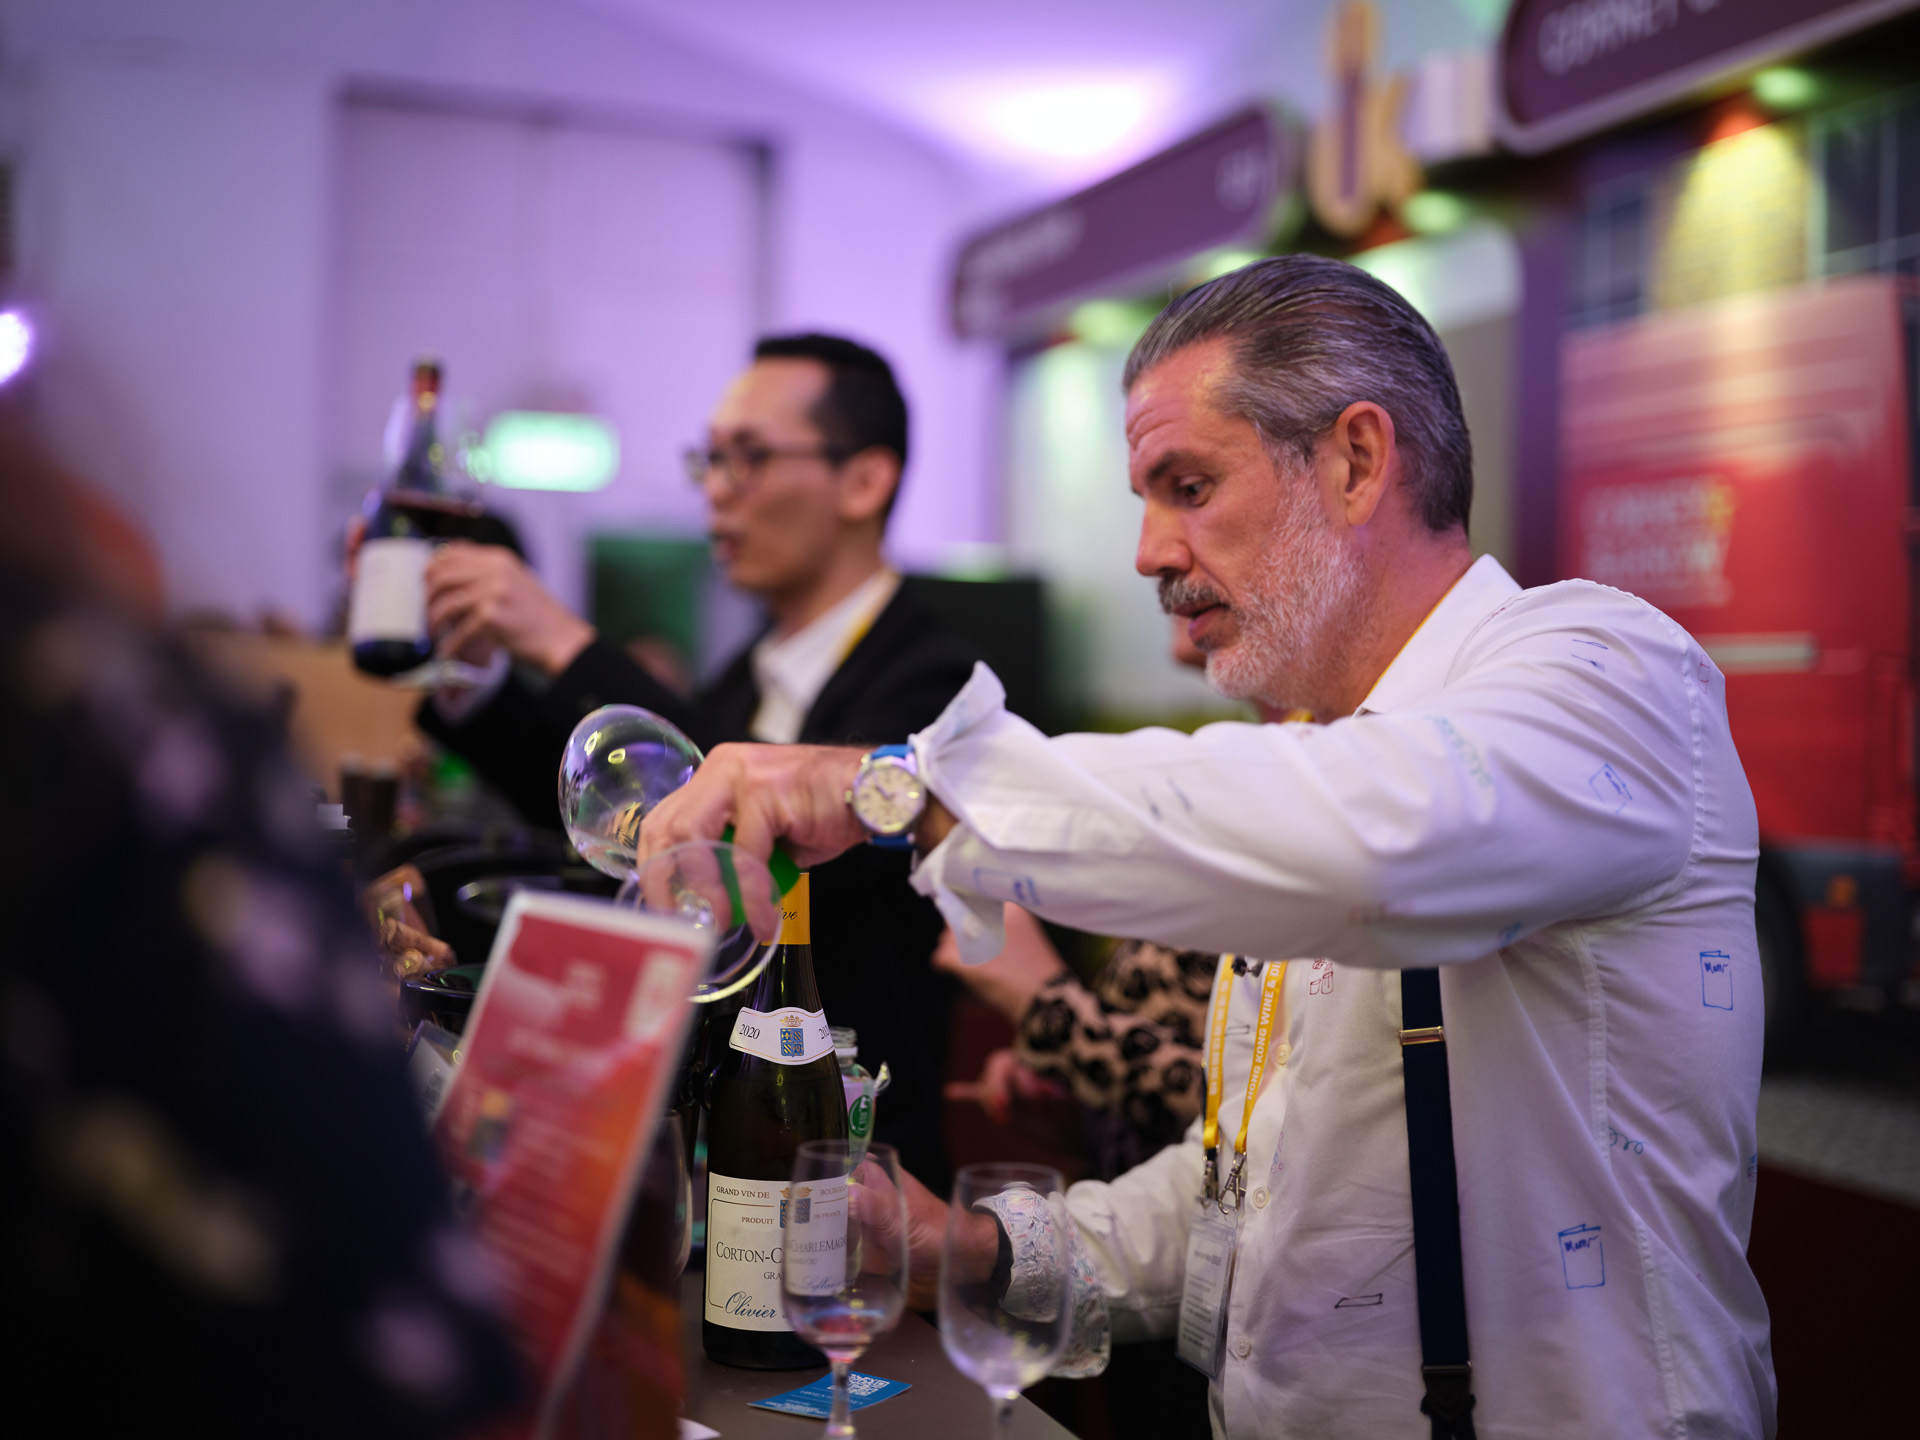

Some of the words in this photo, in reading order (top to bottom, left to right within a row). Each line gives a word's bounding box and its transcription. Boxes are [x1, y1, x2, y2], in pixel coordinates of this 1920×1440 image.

[1266, 979, 1277, 990] &
[1260, 990, 1275, 1026] WINE
[739, 1023, 761, 1040] 2020
[818, 1024, 831, 1040] 202
[1255, 1029, 1268, 1063] KONG
[1247, 1066, 1262, 1100] HONG
[716, 1186, 740, 1196] GRAND
[741, 1190, 756, 1198] VIN
[757, 1191, 770, 1199] DE
[741, 1216, 775, 1225] PRODUIT
[725, 1290, 778, 1319] Olivier
